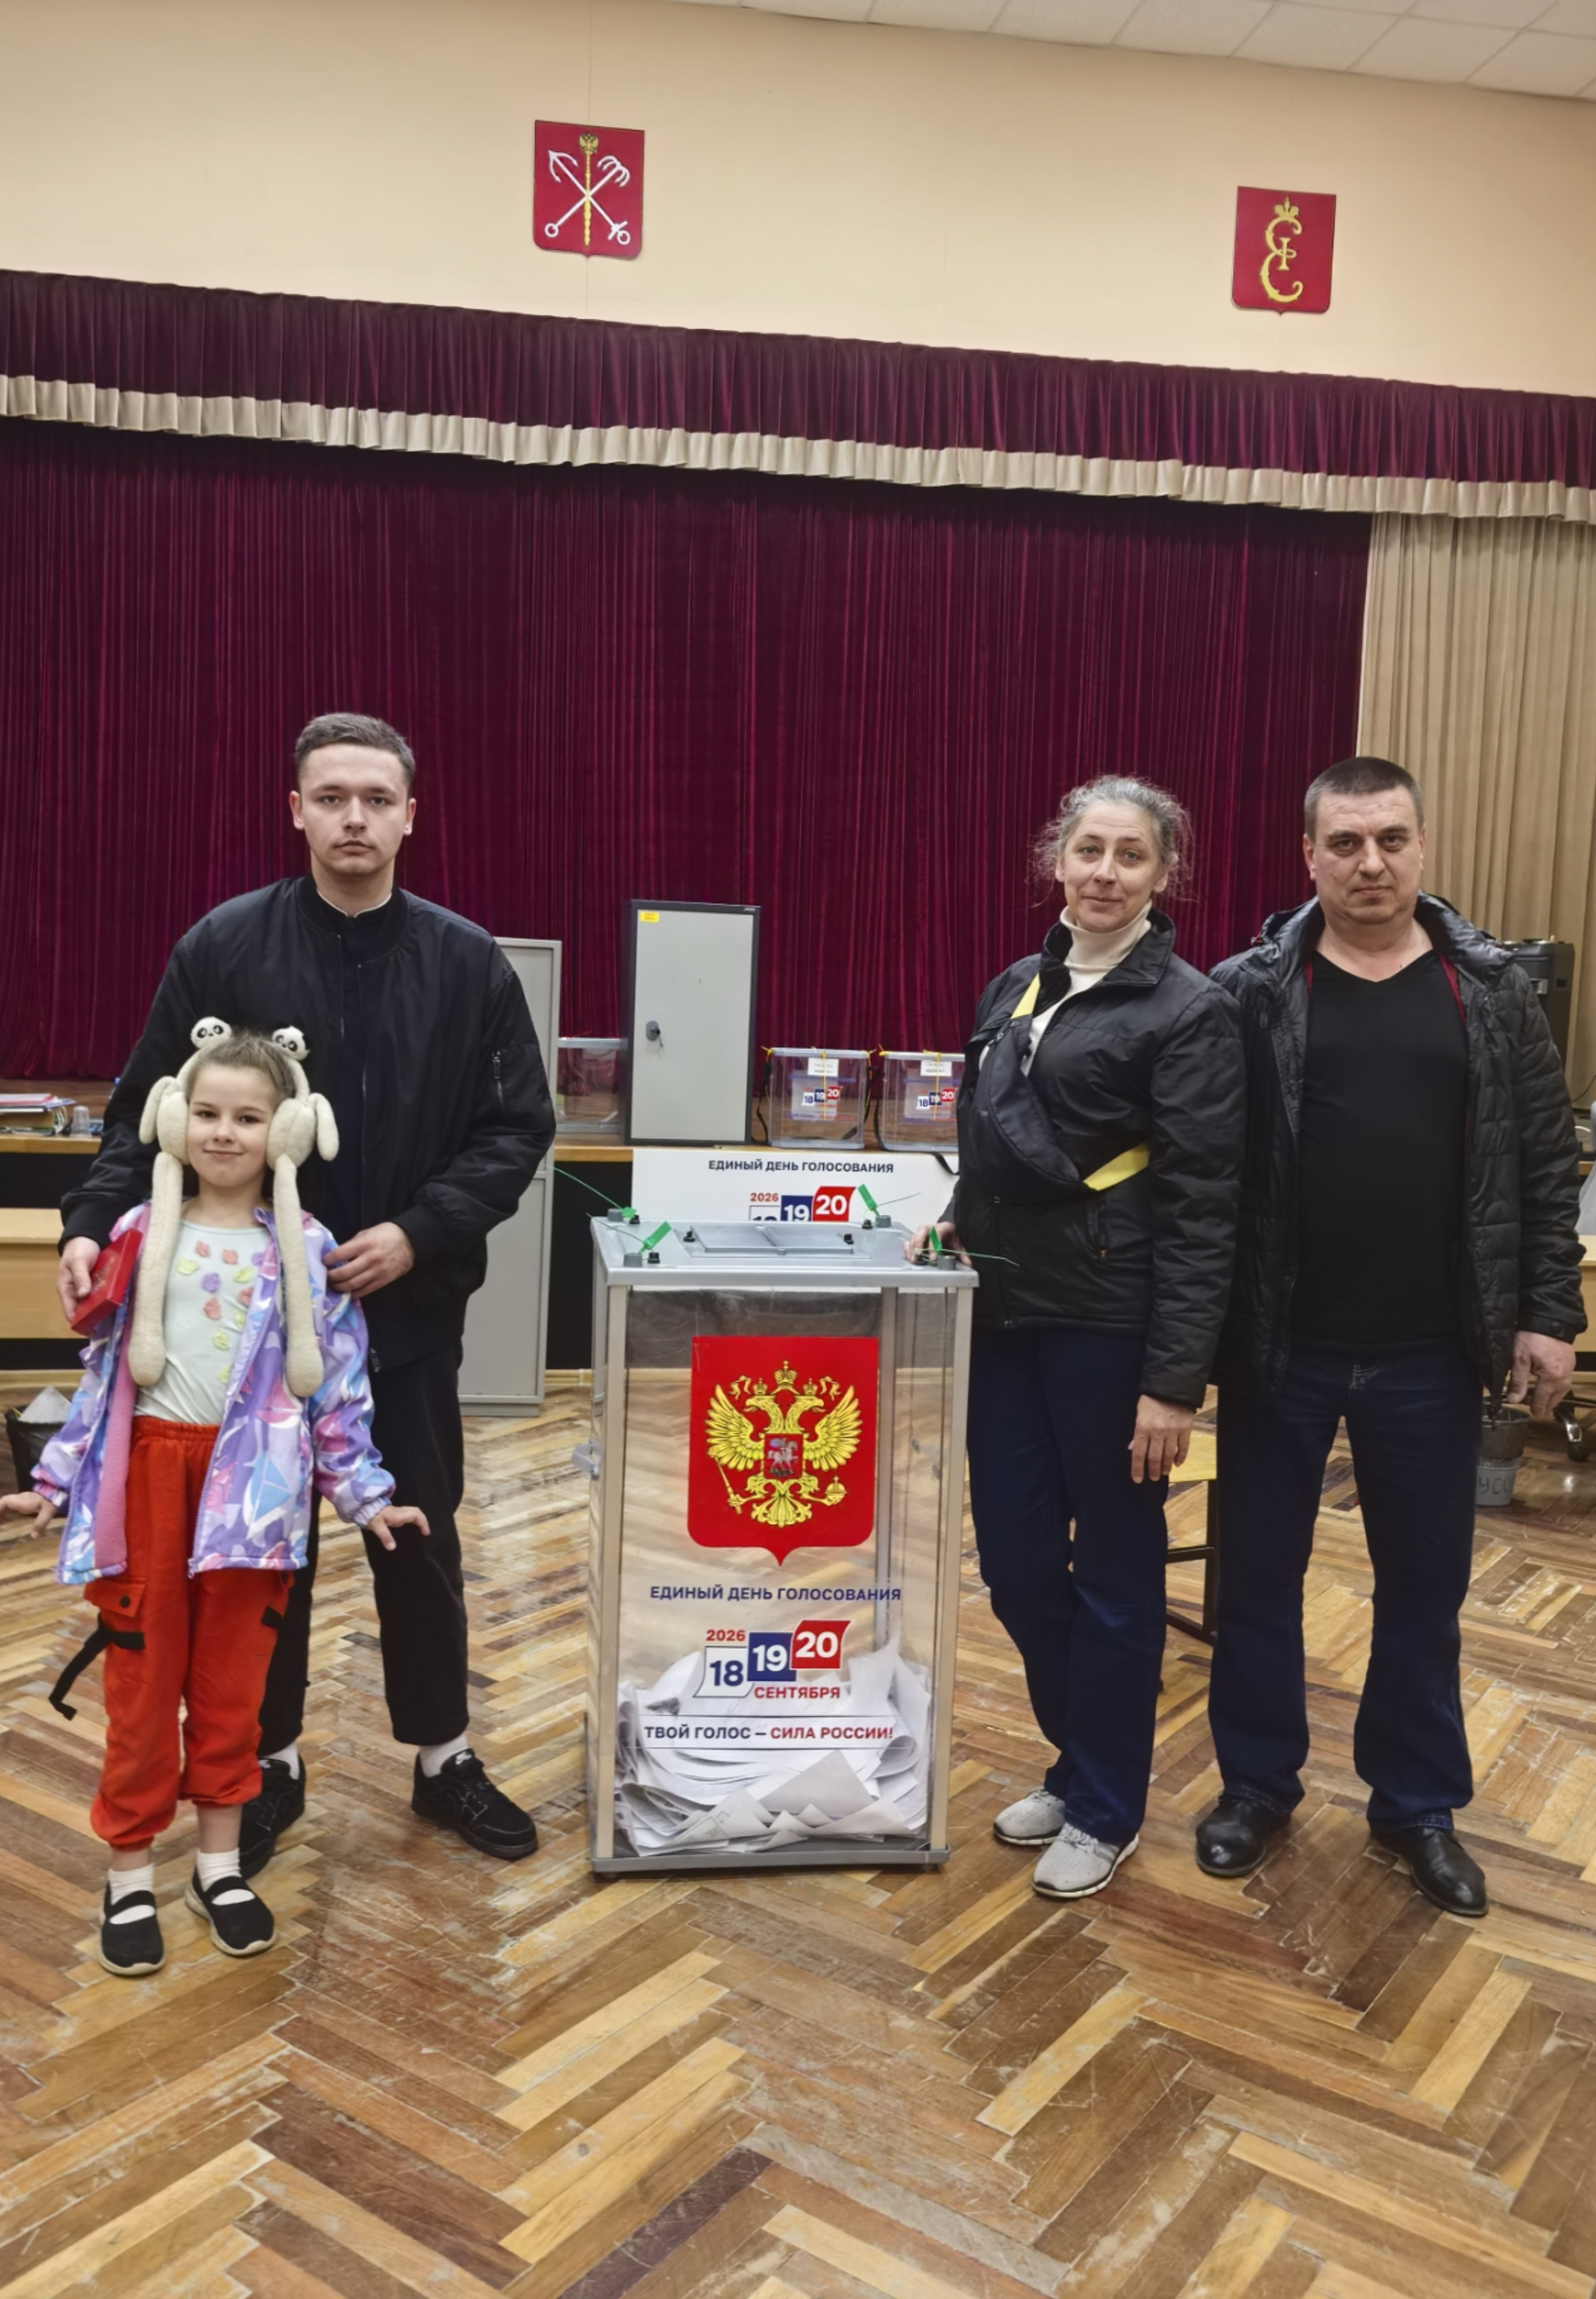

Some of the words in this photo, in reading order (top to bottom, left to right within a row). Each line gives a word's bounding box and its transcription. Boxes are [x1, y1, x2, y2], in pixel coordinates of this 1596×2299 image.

[941, 1091, 953, 1099] 20
[708, 1159, 763, 1171] ЕДИНЫЙ
[765, 1161, 799, 1172] ДЕНЬ
[802, 1161, 894, 1173] ГОЛОСОВАНИЯ
[750, 1192, 779, 1202] 2026
[815, 1195, 847, 1215] 20
[784, 1204, 810, 1221] 19
[651, 1584, 723, 1600] ЕДИНЫЙ
[727, 1587, 773, 1601] ДЕНЬ
[777, 1588, 901, 1601] ГОЛОСОВАНИЯ
[705, 1629, 745, 1642] 2026
[795, 1631, 839, 1658] 20
[752, 1644, 788, 1672] 19
[709, 1660, 744, 1687] 18
[754, 1686, 841, 1699] СЕНТЯБРЯ
[644, 1723, 689, 1739] ТВОЙ
[695, 1727, 751, 1739] ГОЛОС
[770, 1727, 816, 1739] СИЛА
[820, 1727, 893, 1739] РОССИИ!
